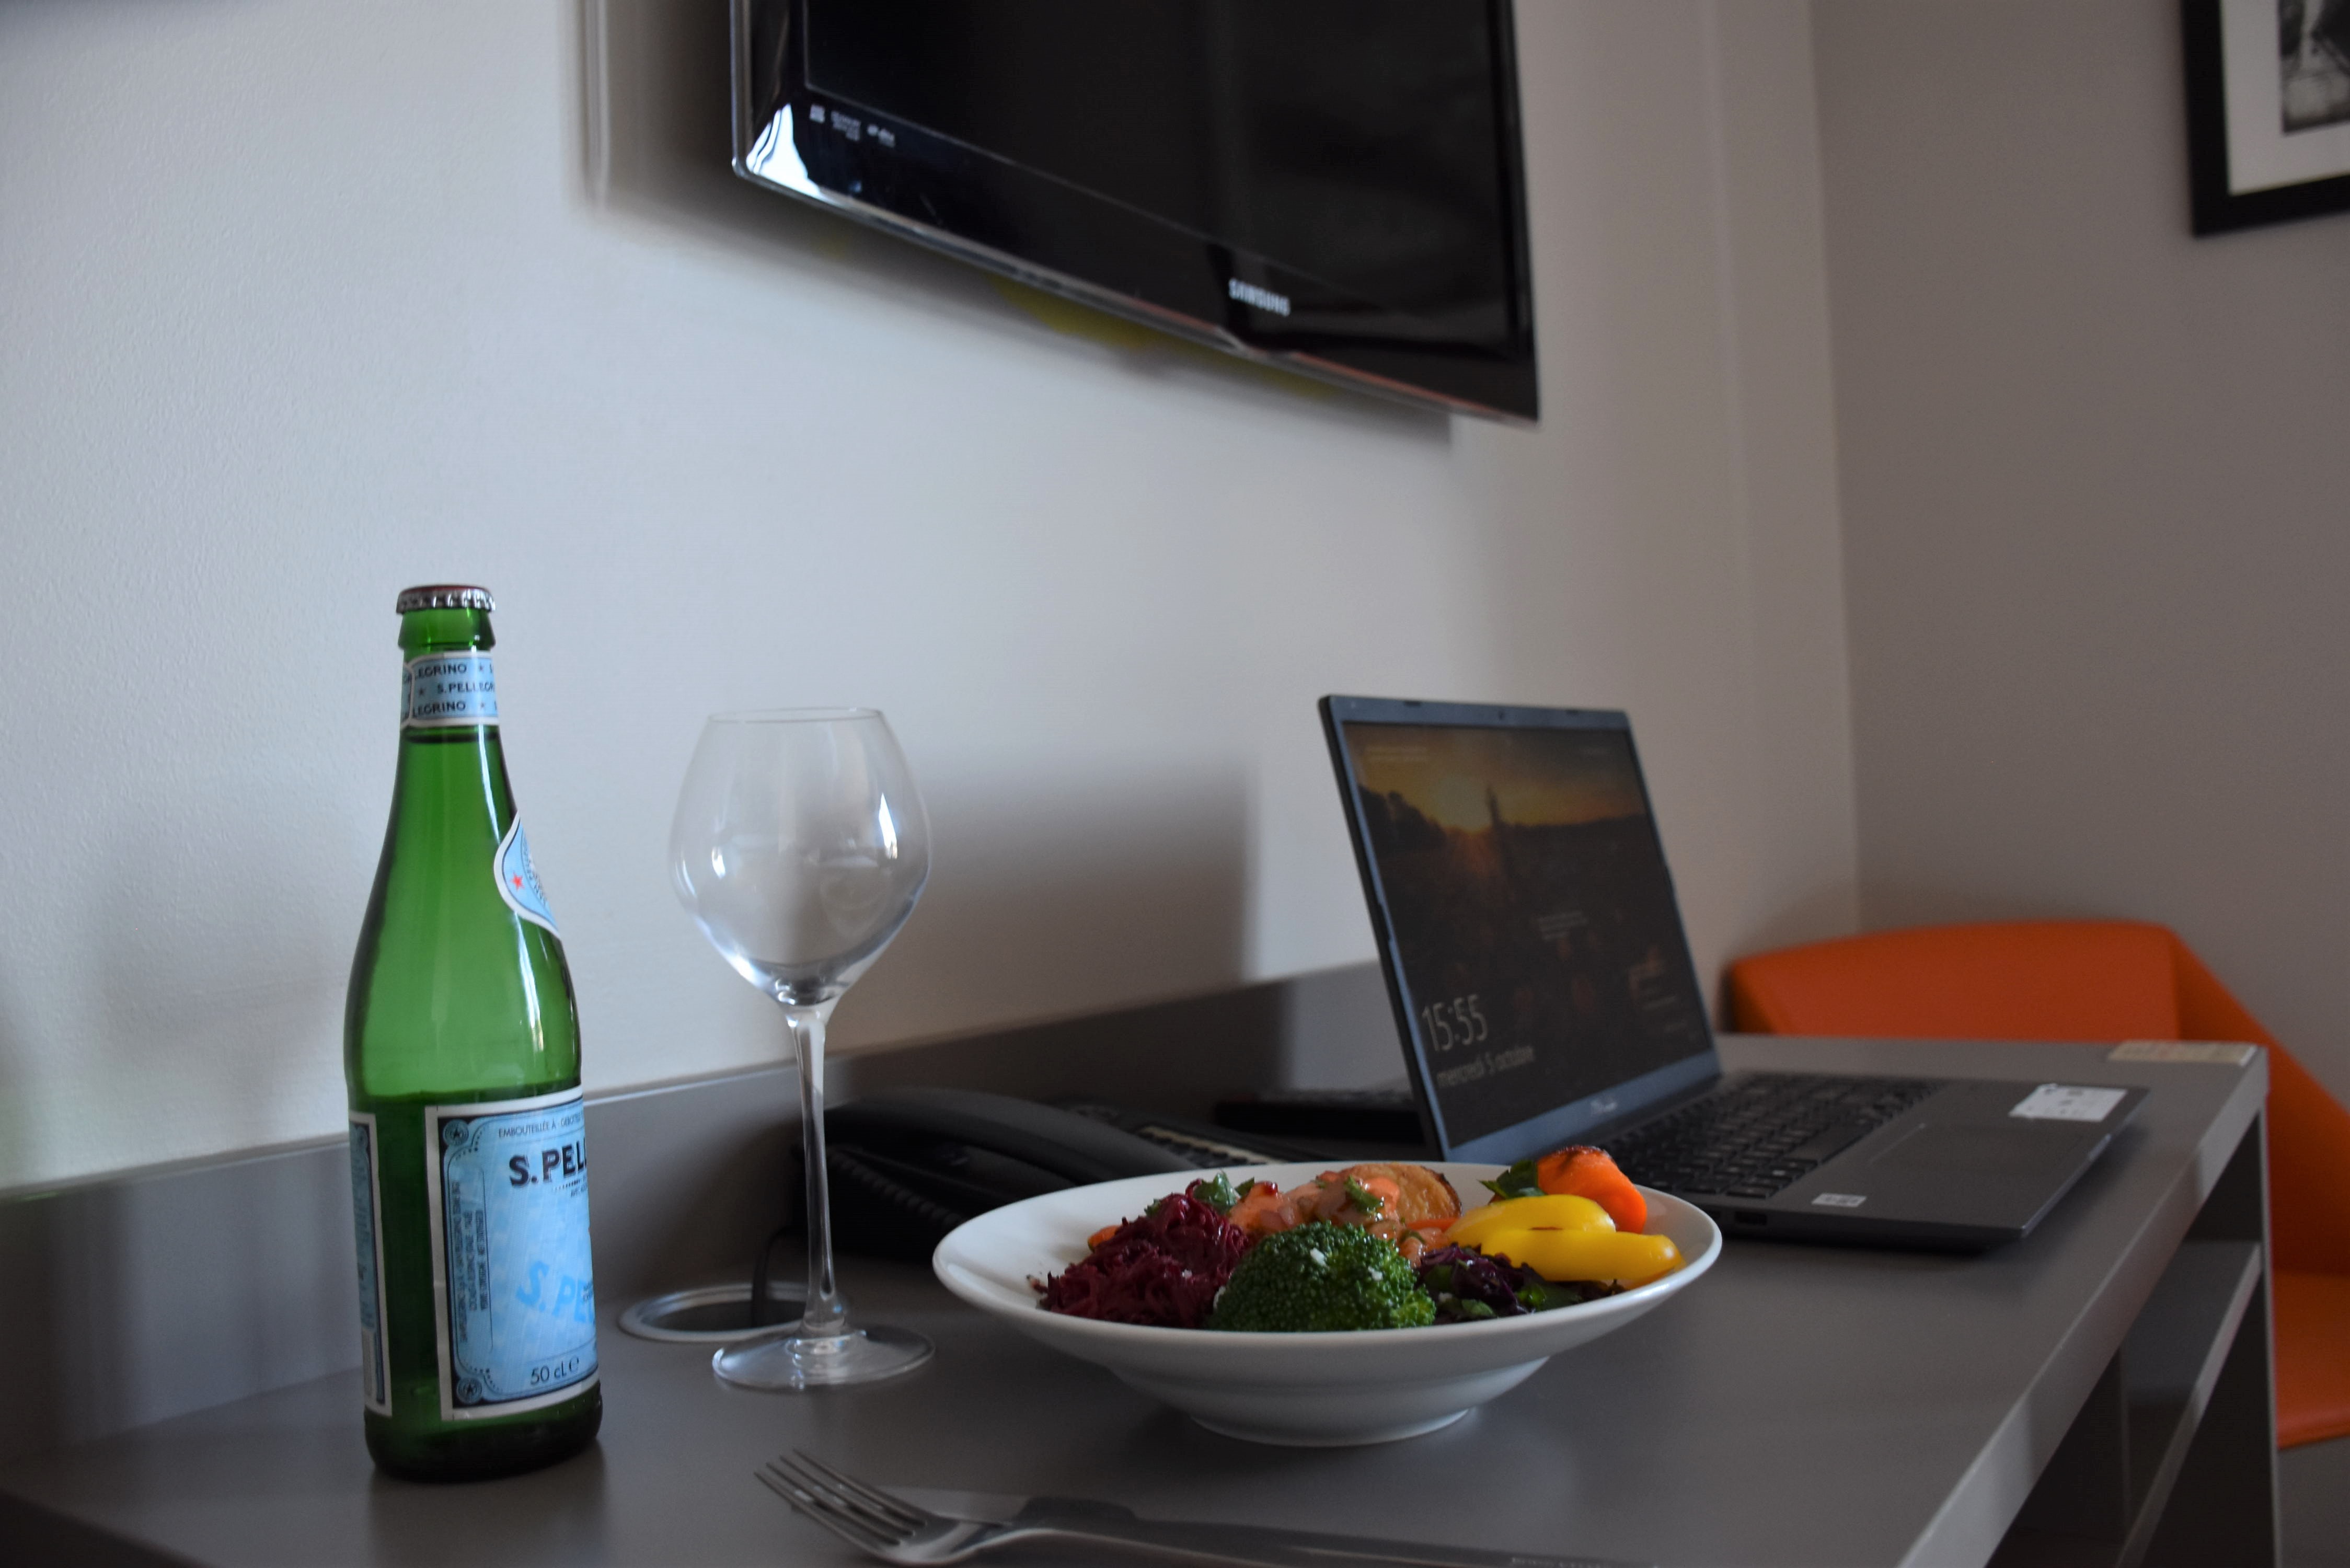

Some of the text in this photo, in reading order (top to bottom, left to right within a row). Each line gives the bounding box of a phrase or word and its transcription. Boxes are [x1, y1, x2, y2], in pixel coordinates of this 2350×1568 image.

[1228, 278, 1291, 316] SAMSUNG
[1422, 994, 1488, 1052] 15:55
[1485, 1052, 1495, 1076] 5
[499, 1120, 549, 1138] EMBOUTEILLÉE
[530, 1365, 549, 1385] 50
